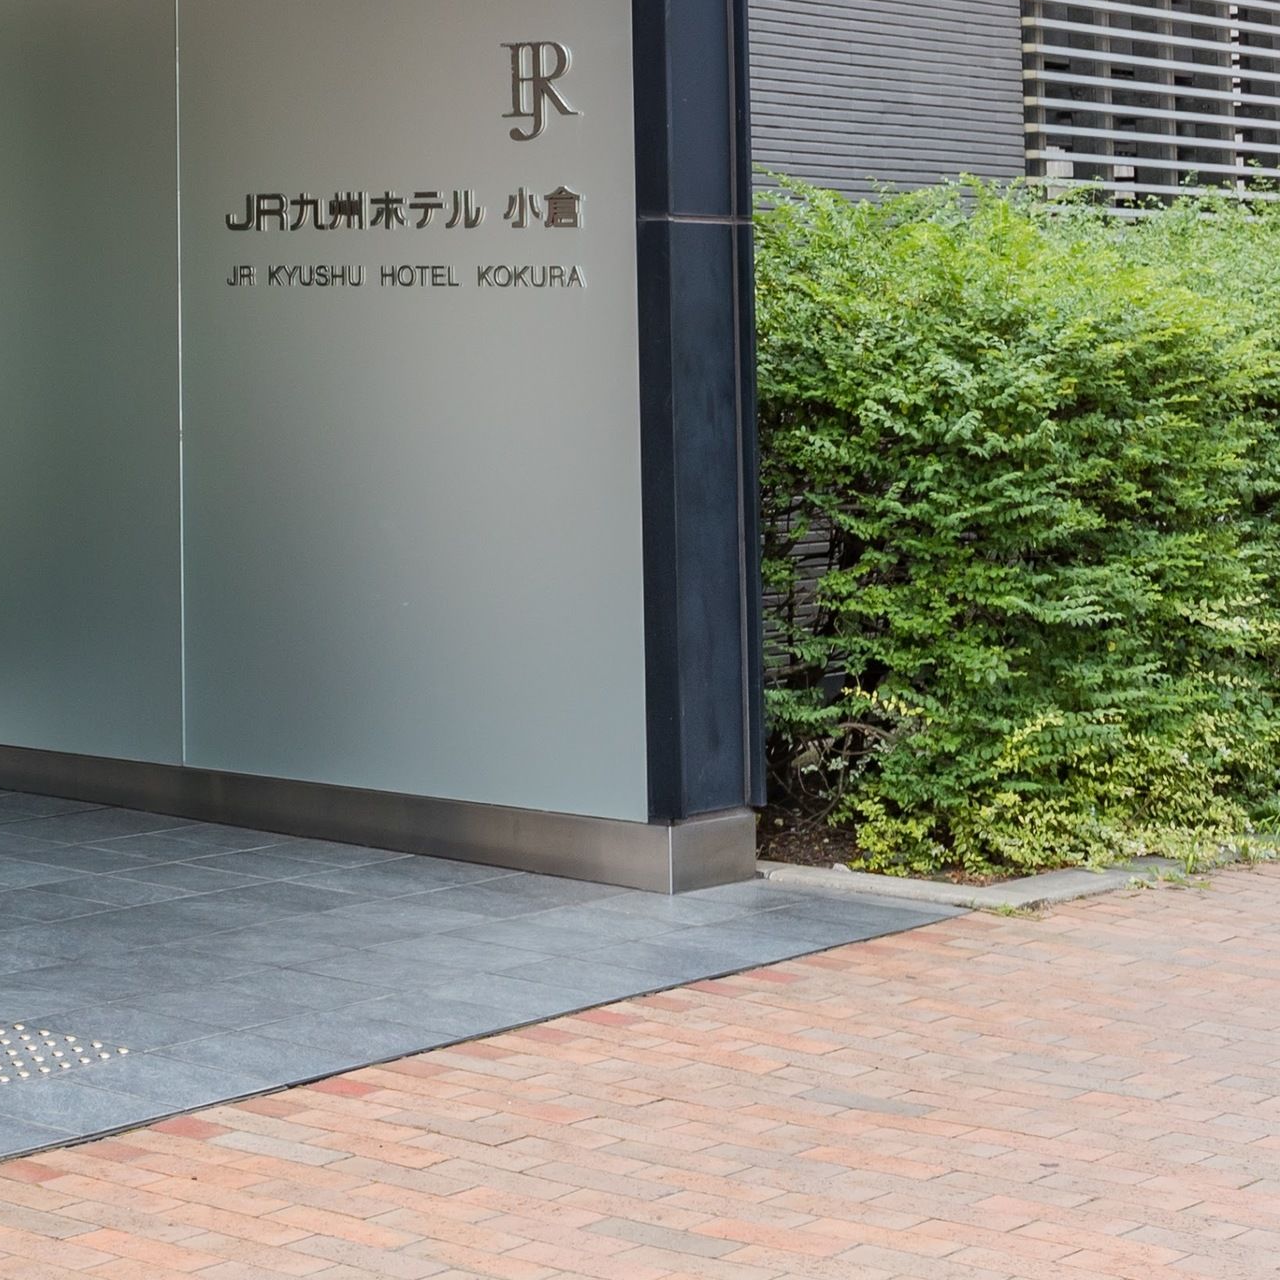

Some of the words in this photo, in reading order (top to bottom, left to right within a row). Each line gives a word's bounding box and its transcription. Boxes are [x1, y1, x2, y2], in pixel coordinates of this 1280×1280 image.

[226, 190, 485, 231] JR九州ホテル
[504, 185, 584, 230] 小倉
[226, 265, 255, 287] JR
[268, 265, 364, 287] KYUSHU
[380, 265, 460, 287] HOTEL
[477, 265, 586, 287] KOKURA
